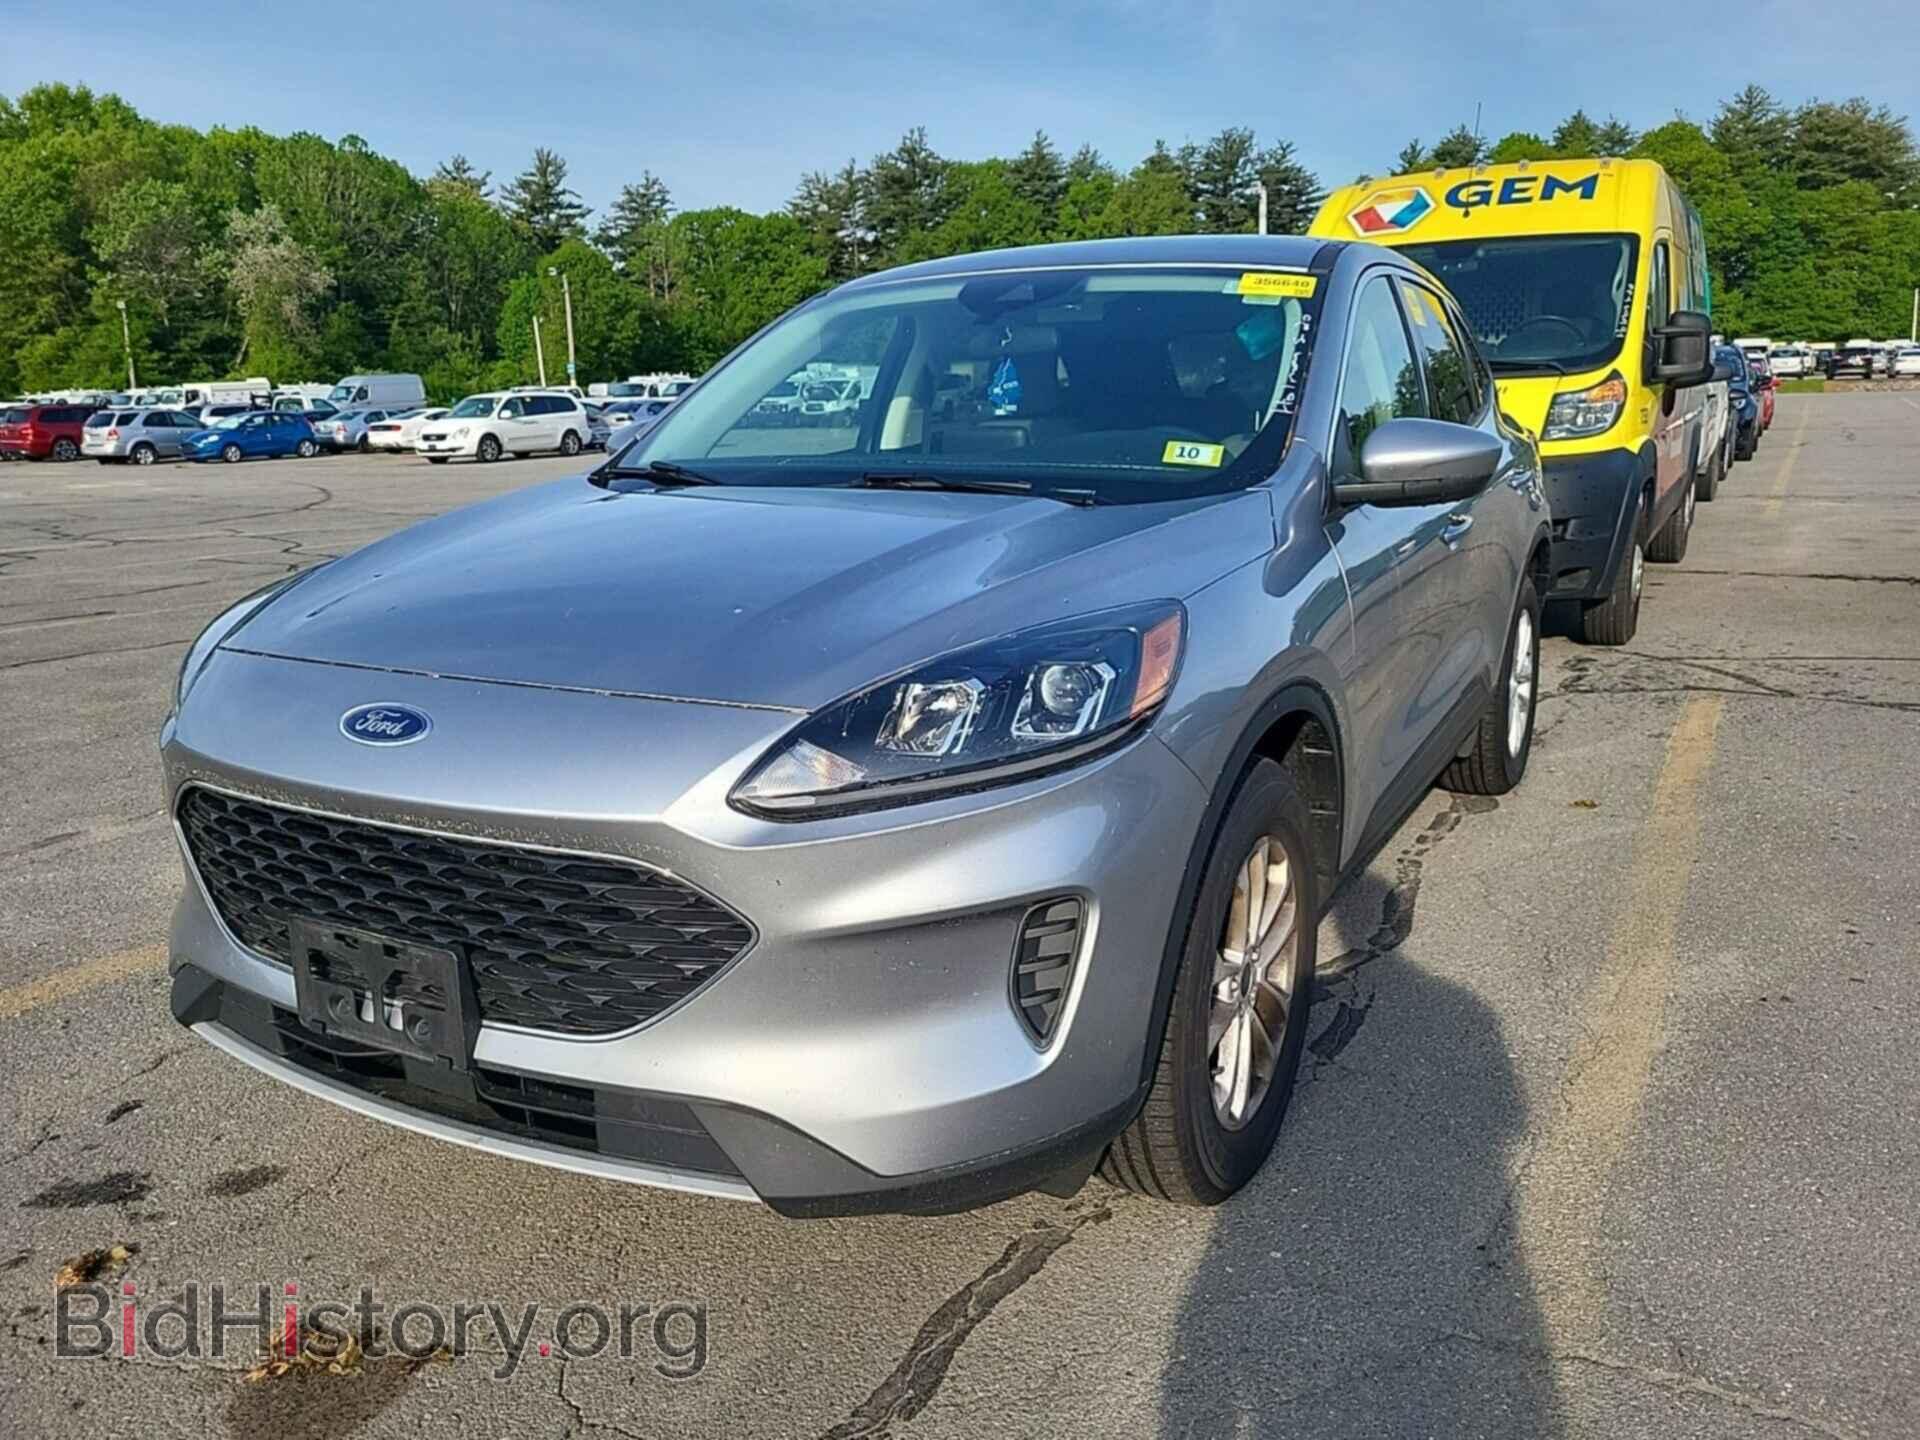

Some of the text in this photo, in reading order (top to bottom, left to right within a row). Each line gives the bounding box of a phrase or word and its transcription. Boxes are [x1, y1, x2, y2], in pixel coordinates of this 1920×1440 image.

[1445, 173, 1599, 208] GEM
[1176, 446, 1200, 459] 10
[355, 709, 410, 736] Ford
